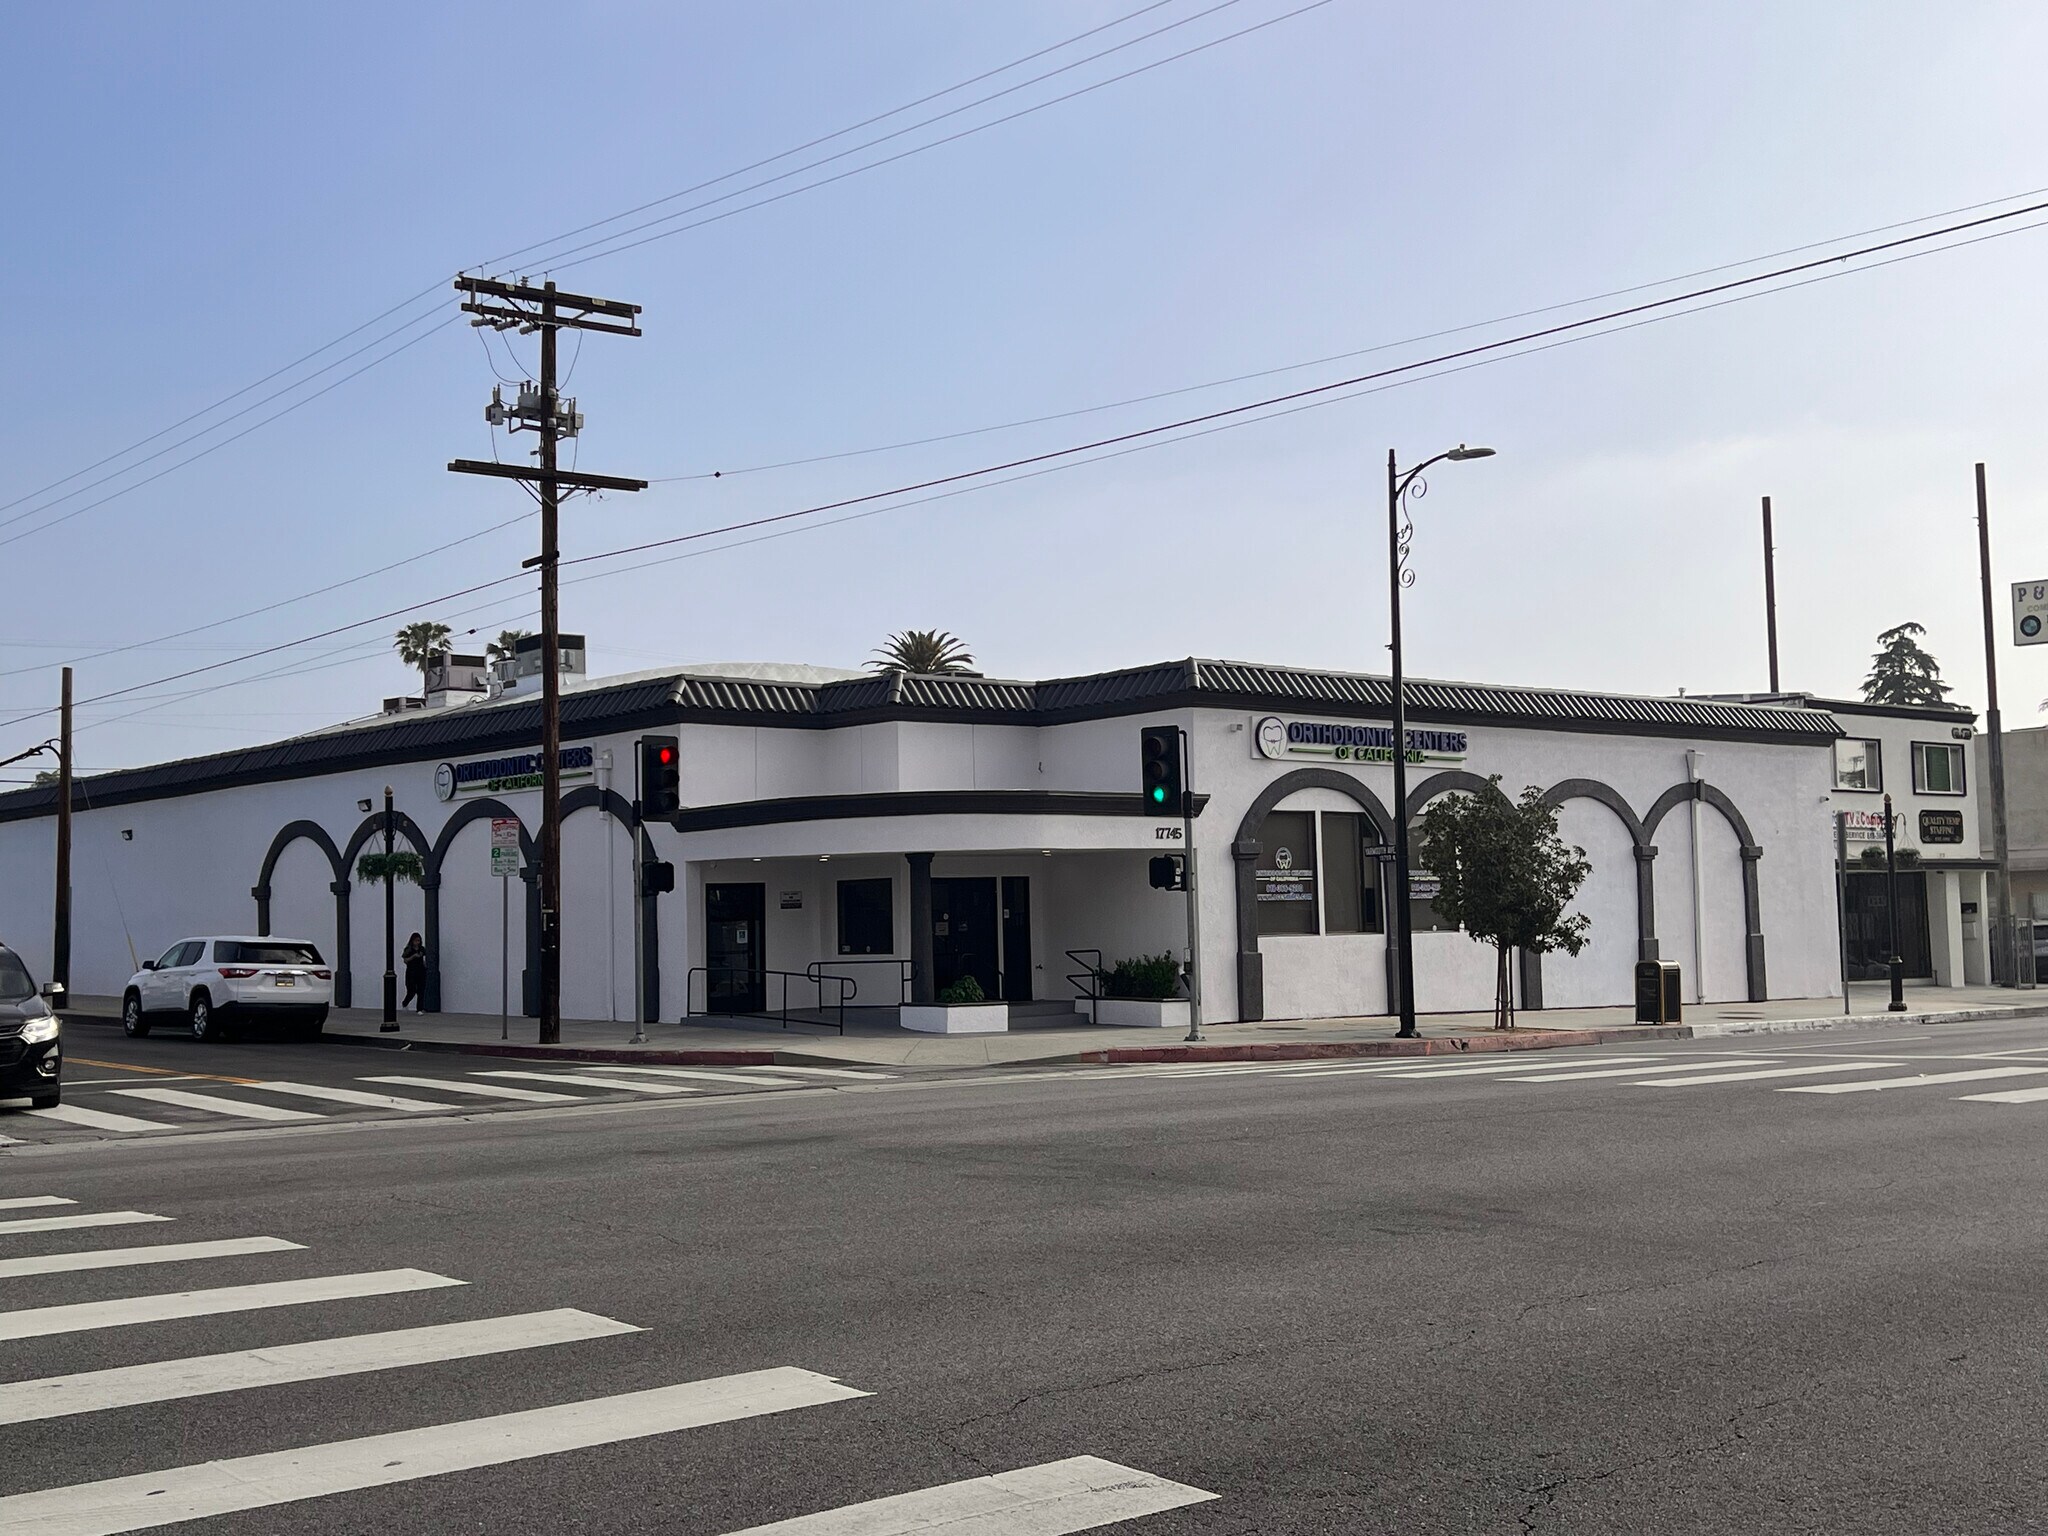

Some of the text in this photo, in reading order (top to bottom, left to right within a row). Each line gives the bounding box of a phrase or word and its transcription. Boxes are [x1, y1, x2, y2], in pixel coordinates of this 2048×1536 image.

[2018, 585, 2045, 602] P &
[1288, 722, 1467, 751] ORTHODONTIC CENTERS
[1335, 747, 1425, 763] OF CALIFONIA
[456, 746, 593, 783] ORTHODONTIC CTERS
[488, 774, 544, 792] OF CALIFORN
[1155, 827, 1183, 840] 17745
[493, 848, 500, 857] 2
